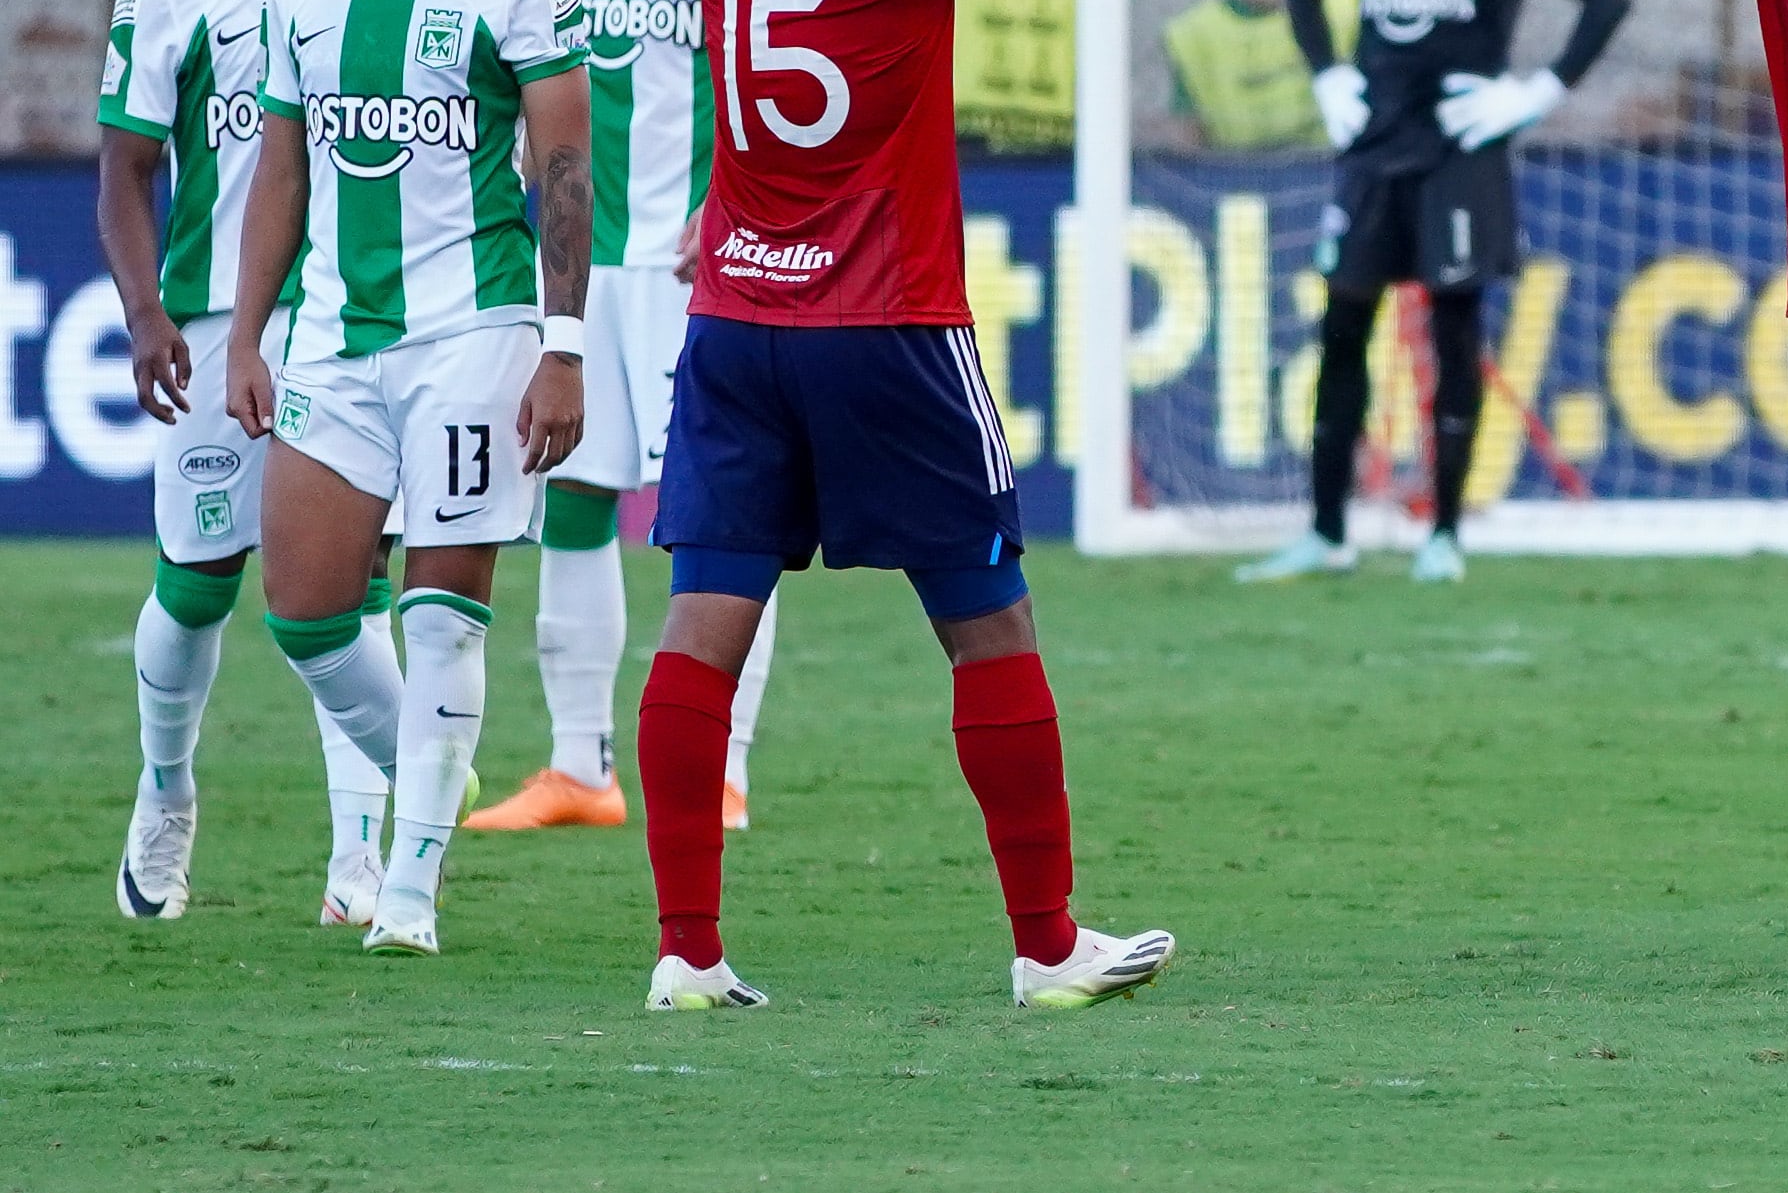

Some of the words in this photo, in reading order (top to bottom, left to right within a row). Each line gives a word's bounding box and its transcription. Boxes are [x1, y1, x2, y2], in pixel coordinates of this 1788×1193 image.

[304, 92, 479, 152] OSTOBON
[183, 454, 236, 470] ARESS
[443, 424, 490, 497] 13
